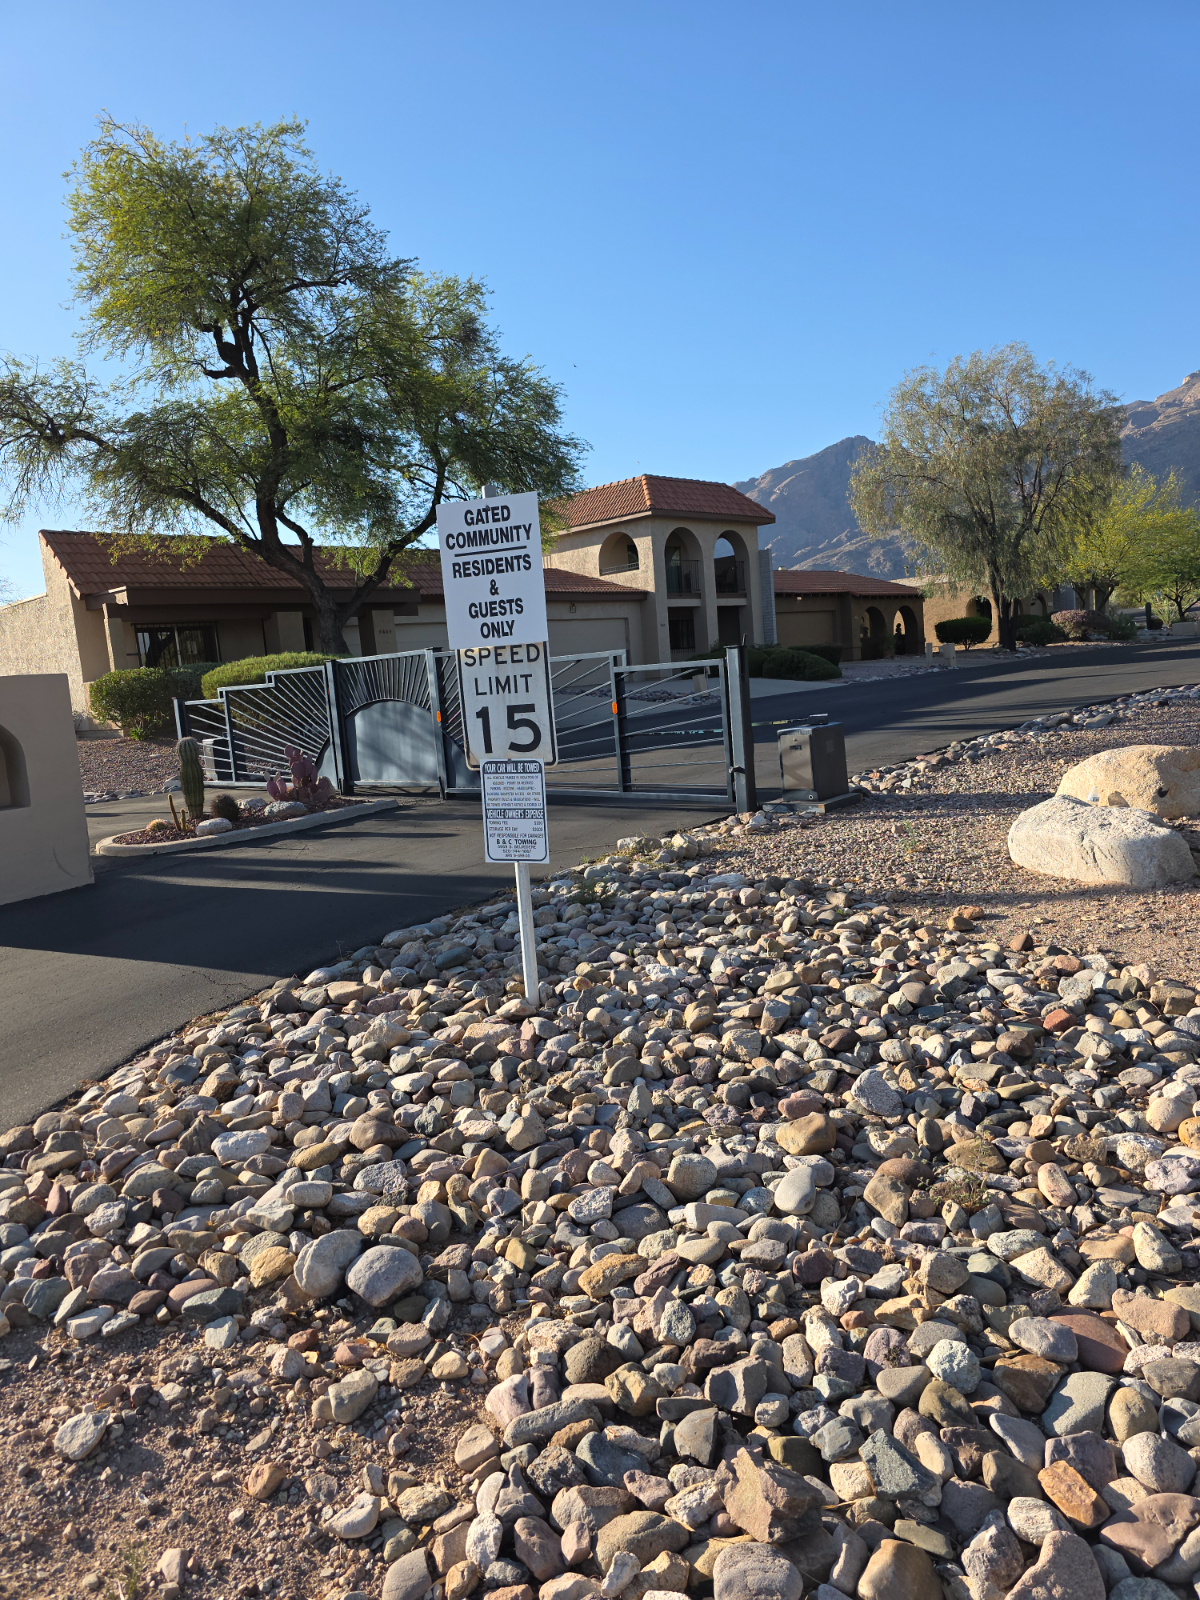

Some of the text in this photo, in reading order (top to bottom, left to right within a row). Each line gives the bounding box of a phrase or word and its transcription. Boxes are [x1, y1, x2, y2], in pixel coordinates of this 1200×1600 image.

[464, 505, 511, 526] GATED
[445, 523, 532, 550] COMMUNITY
[452, 554, 532, 578] RESIDENTS
[489, 579, 499, 596] &
[468, 598, 524, 619] GUESTS
[480, 619, 515, 639] ONLY
[464, 643, 540, 667] SPEED
[474, 674, 533, 696] LIMIT
[475, 703, 542, 754] 15
[484, 762, 540, 773] YOUR CAR WILL BE TOWED
[487, 809, 505, 819] VEHICLE
[525, 809, 544, 819] EXPENSE
